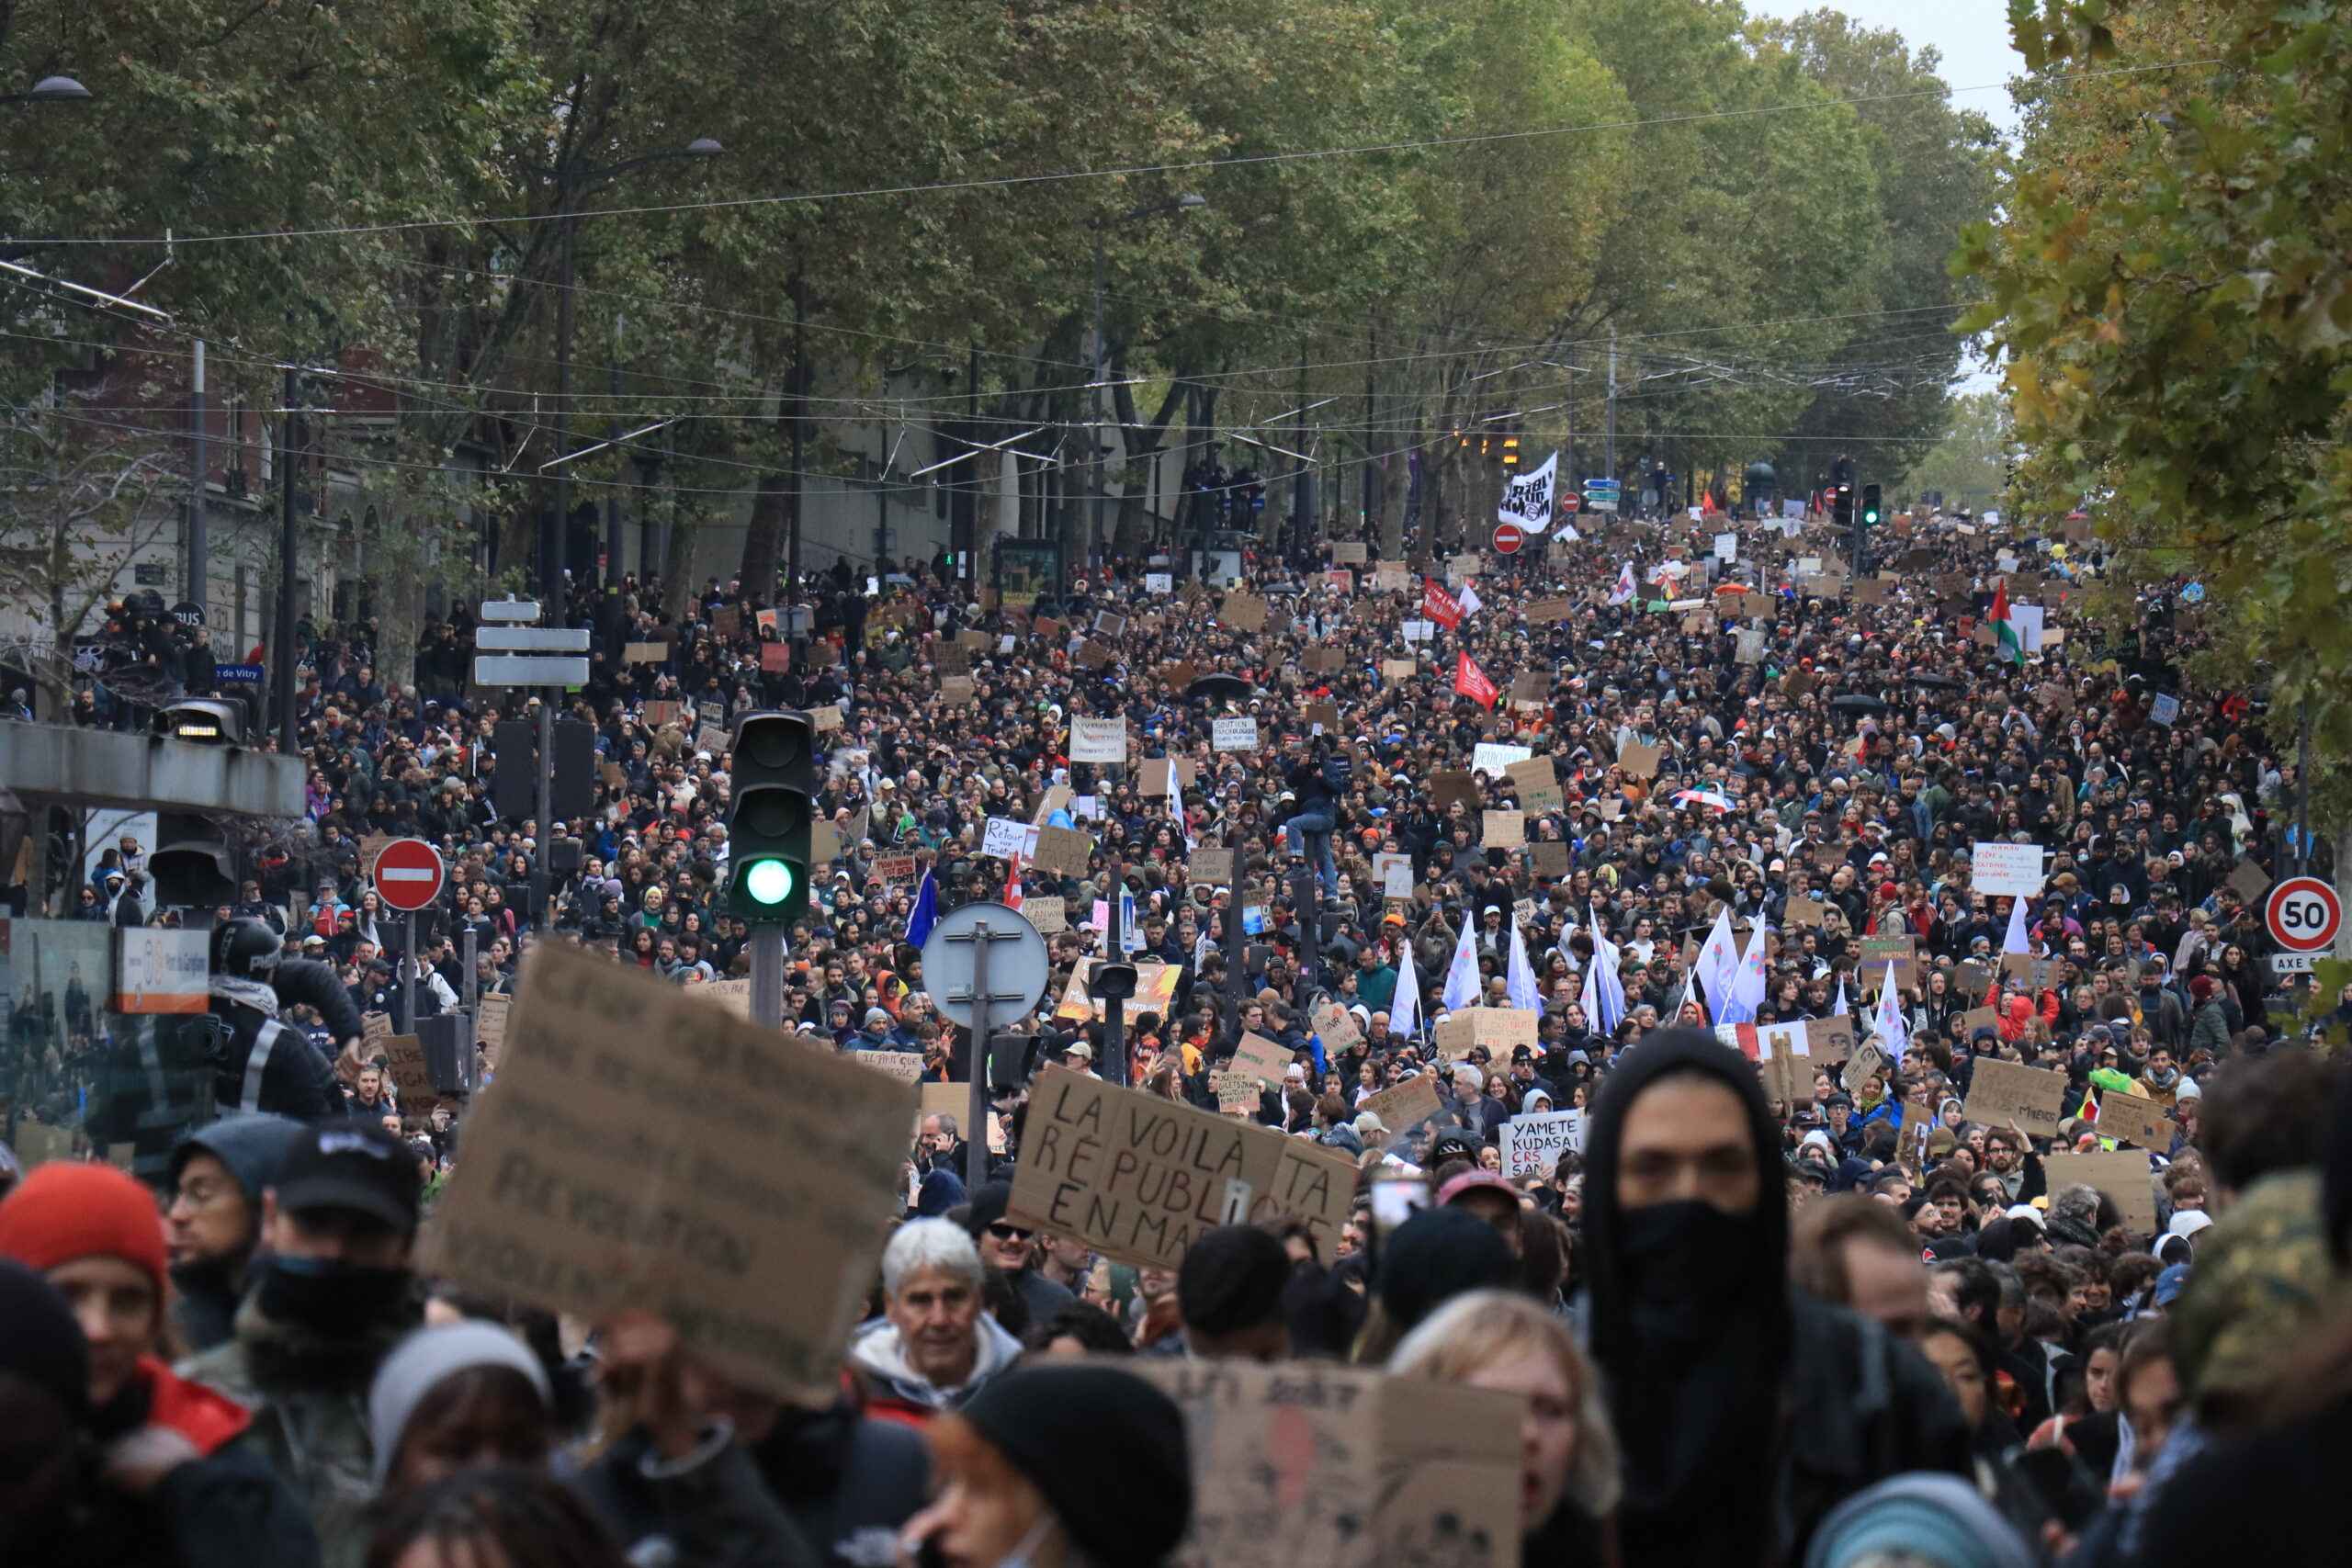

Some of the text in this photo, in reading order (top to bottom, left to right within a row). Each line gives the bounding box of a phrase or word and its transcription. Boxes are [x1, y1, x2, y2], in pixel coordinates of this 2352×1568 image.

[222, 669, 234, 678] de
[235, 669, 257, 680] Vitry
[1216, 720, 1248, 728] SOUTIEN
[987, 820, 1023, 839] Retour
[1049, 829, 1088, 852] PAS
[1976, 851, 1997, 859] FIÈRE
[887, 873, 915, 886] MORT
[2284, 901, 2324, 929] 50
[1880, 951, 1911, 959] PARTAGE
[2278, 958, 2303, 969] AXE
[900, 1056, 919, 1068] QUE
[1513, 1119, 1578, 1138] YAMETE
[1053, 1083, 1102, 1135] LA
[1285, 1153, 1331, 1214] TA
[1511, 1149, 1542, 1164] CRS
[1048, 1182, 1121, 1238] EN
